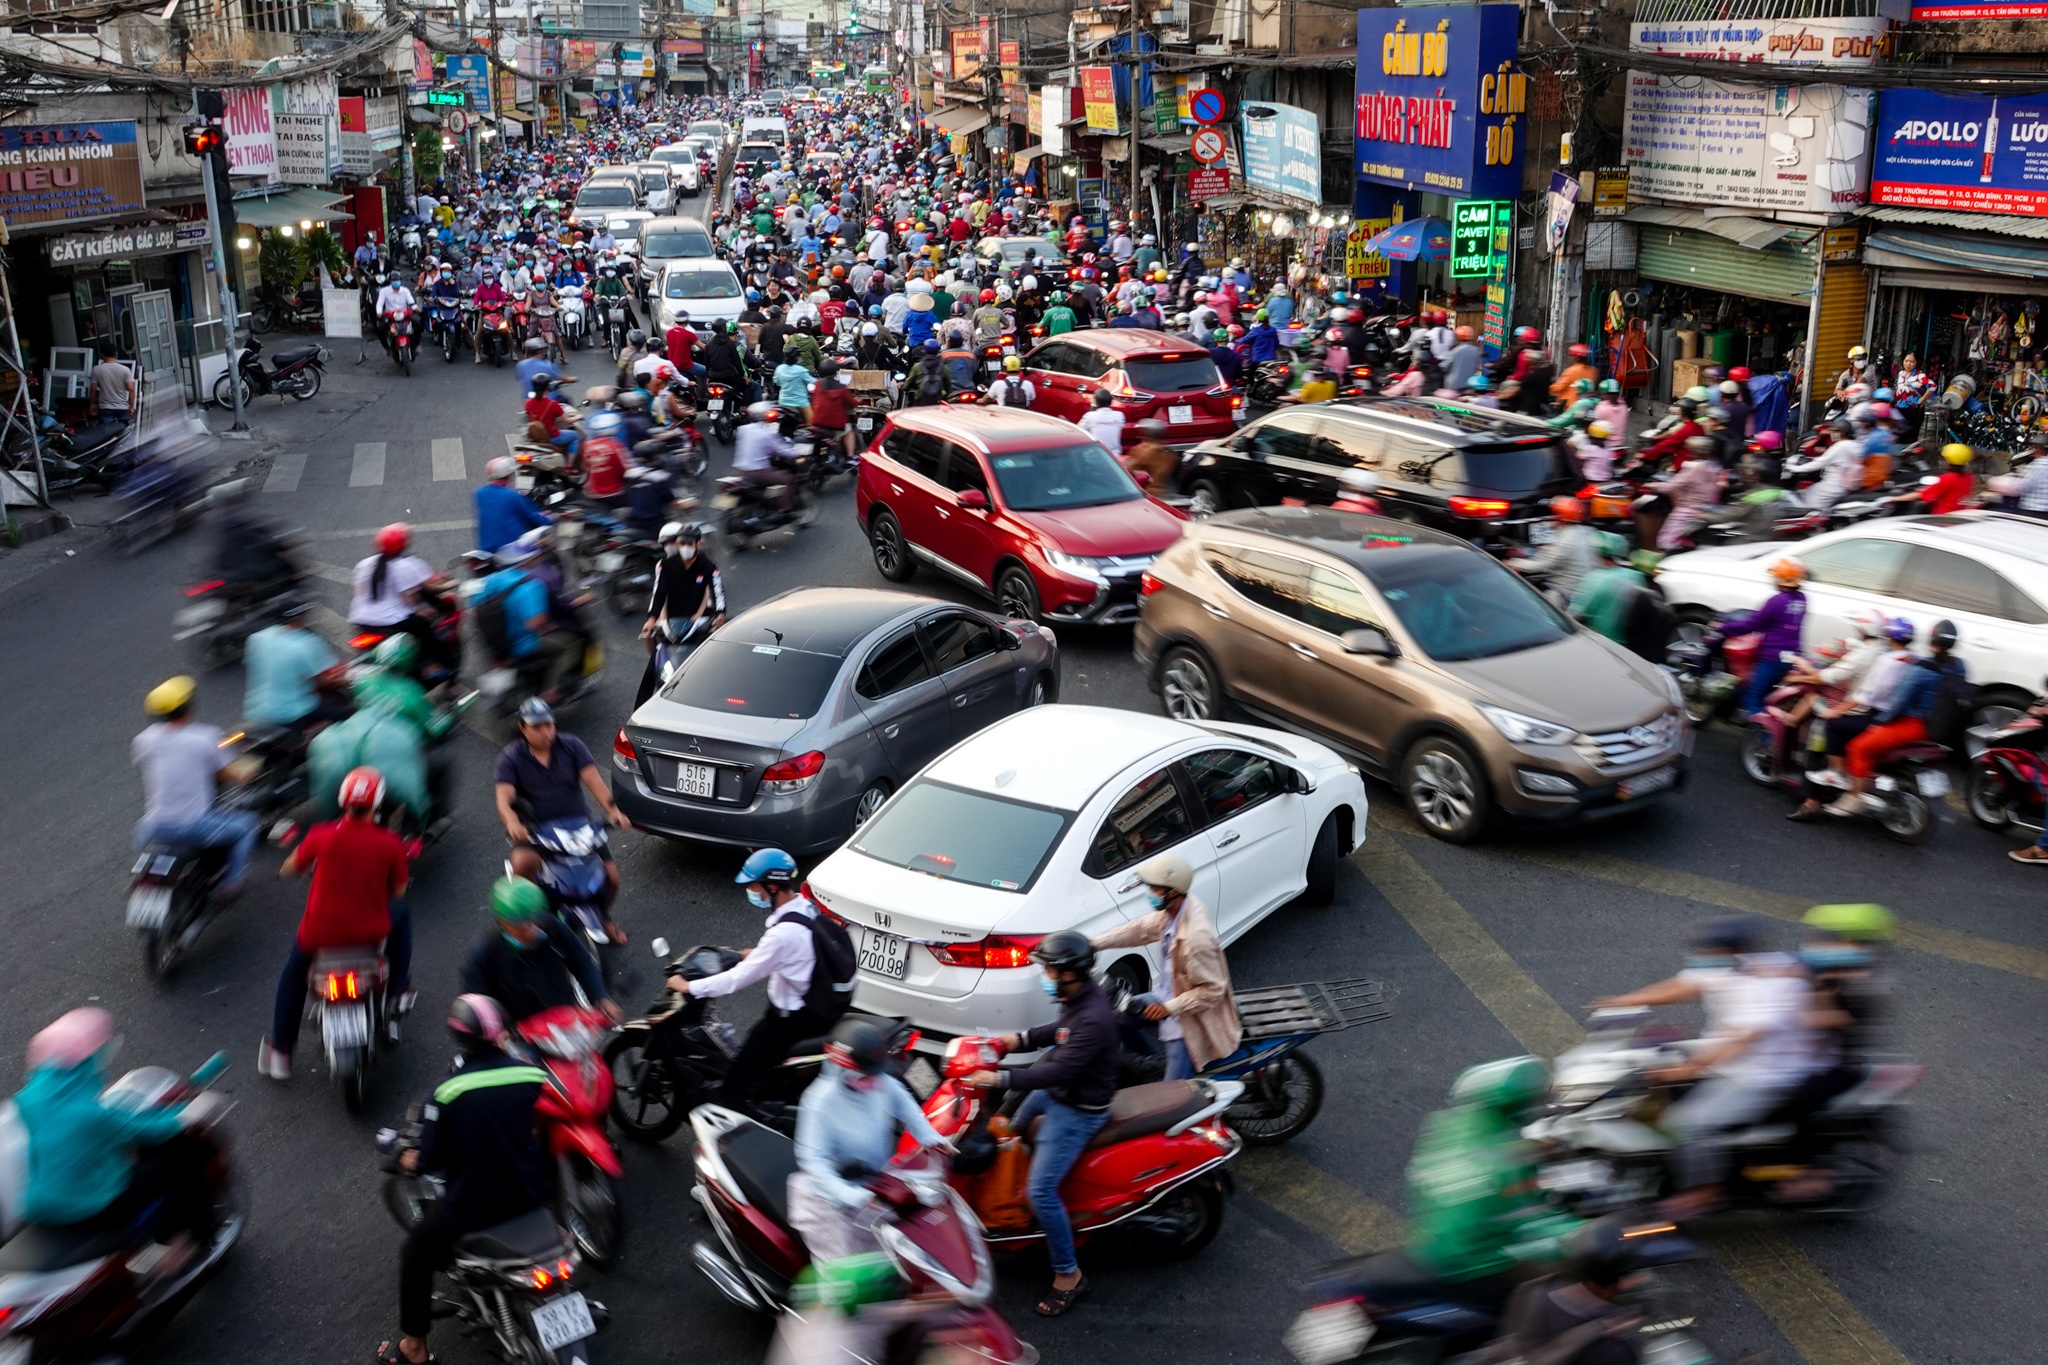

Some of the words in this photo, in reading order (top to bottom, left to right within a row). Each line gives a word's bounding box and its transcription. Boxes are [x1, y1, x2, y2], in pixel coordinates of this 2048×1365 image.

[1669, 25, 1686, 42] THIẾT
[1722, 22, 1743, 42] TỔNG
[1745, 28, 1762, 45] HỢP
[1768, 34, 1793, 51] Phi
[1383, 19, 1421, 76] CẦM
[1422, 19, 1449, 76] ĐỒ
[1832, 35, 1873, 58] Phi
[1481, 60, 1527, 114] CẦM
[295, 117, 324, 126] NGHE
[1357, 90, 1406, 144] HƯNG
[1405, 87, 1456, 149] PHÁT
[276, 132, 293, 141] TAI
[297, 133, 324, 142] BASS
[1894, 120, 1979, 142] APOLLO
[1486, 115, 1517, 166] ĐỒ
[26, 145, 66, 164] KÍNH
[69, 142, 114, 160] NHÔM
[244, 143, 275, 168] THOẠI
[291, 166, 325, 176] BLUETOOTH
[1904, 186, 1928, 195] TRƯỜNG
[1929, 189, 1948, 197] CHINH,
[1973, 190, 1985, 199] TÂN
[2014, 194, 2029, 202] HCM
[2036, 196, 2047, 204] ĐT:
[1917, 196, 1933, 205] SÁNG
[1457, 227, 1489, 238] CAVET
[52, 238, 85, 262] CẮT
[86, 233, 134, 257] KIẾNG
[1467, 240, 1476, 253] 3
[1349, 264, 1355, 275] 3
[1358, 259, 1387, 276] TRIỆU
[1454, 254, 1489, 271] TRIỆU
[1052, 313, 1071, 321] Grab
[687, 765, 706, 780] 51G
[678, 778, 711, 796] 030.61
[873, 935, 898, 954] 51G
[861, 950, 904, 976] 700.98
